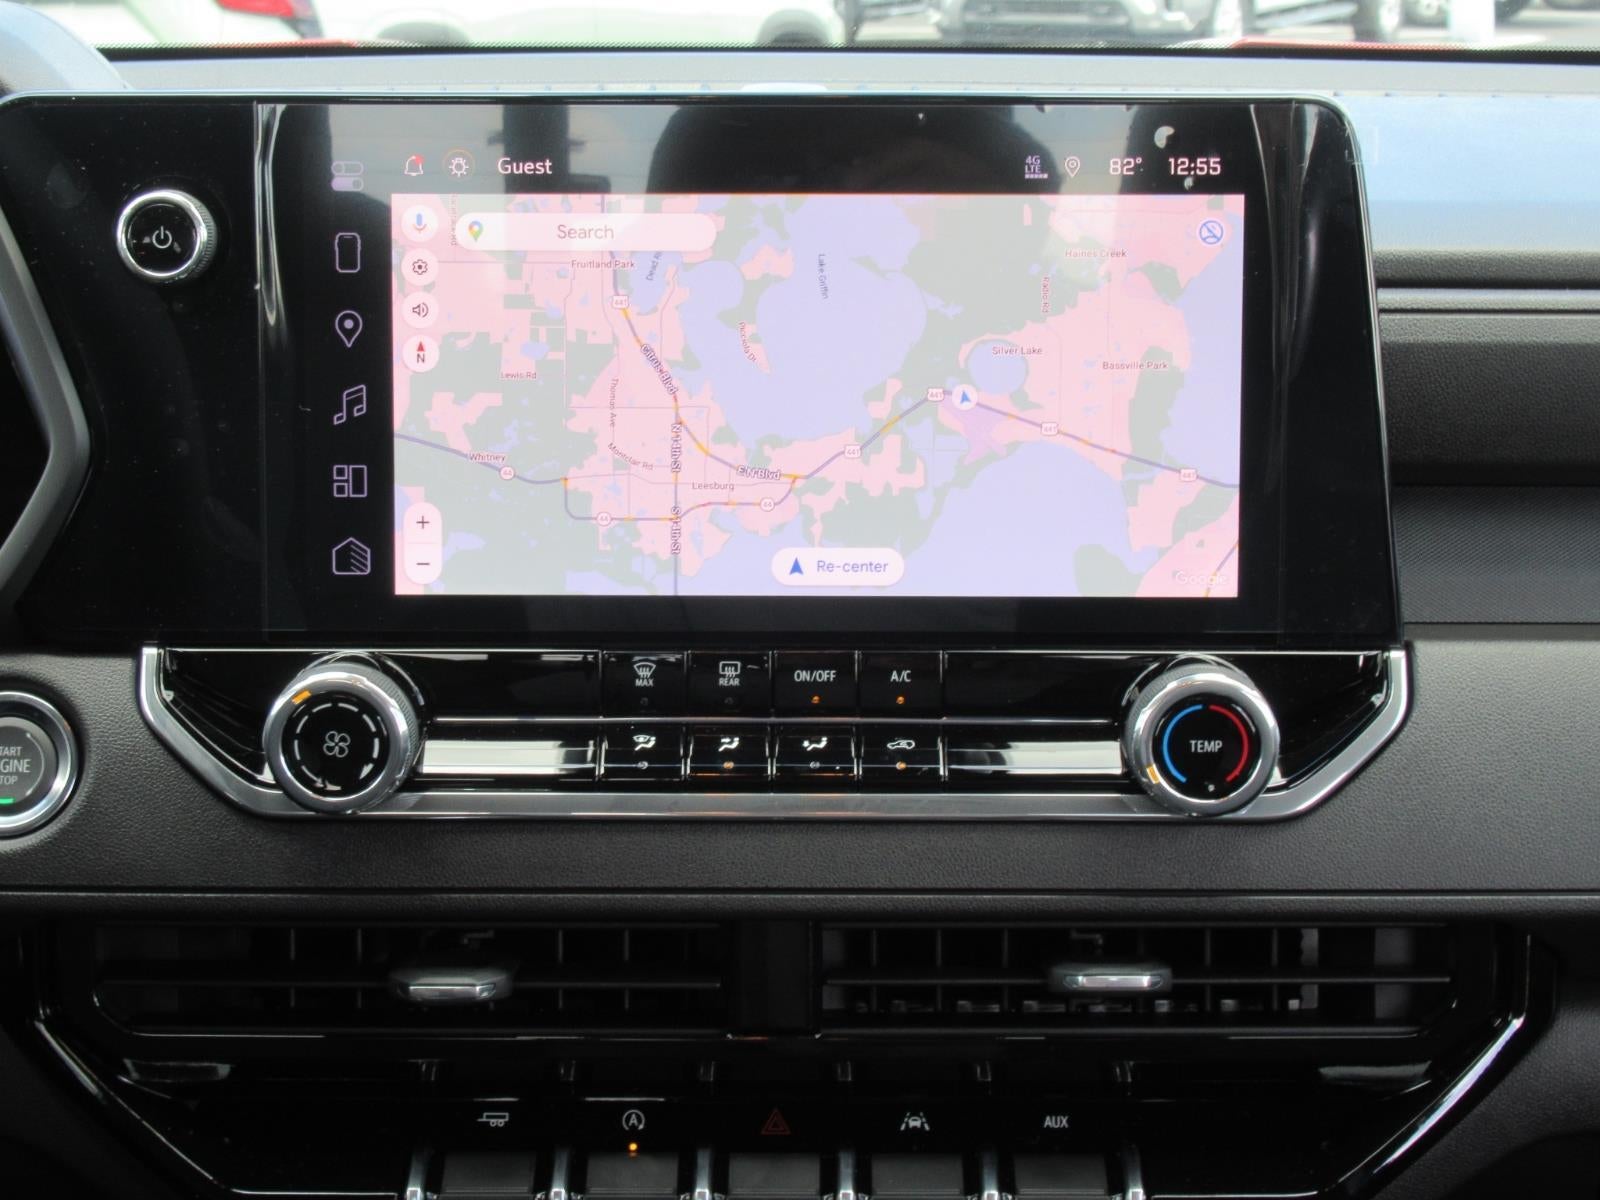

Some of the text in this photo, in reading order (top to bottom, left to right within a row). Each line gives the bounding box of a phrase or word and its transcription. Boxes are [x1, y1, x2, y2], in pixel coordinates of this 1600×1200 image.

[497, 157, 553, 174] Guest
[1025, 155, 1040, 165] 4G
[1025, 165, 1041, 174] LTE
[1168, 157, 1221, 175] 12:55
[557, 224, 614, 240] Search
[1065, 249, 1127, 258] Haines Creek
[571, 259, 635, 269] Fruitland Park
[818, 254, 826, 274] Lake
[992, 346, 1042, 355] Silver Lake
[416, 353, 426, 364] N
[1102, 361, 1168, 370] Bassville Park
[501, 371, 537, 380] Lewis Rd
[609, 378, 619, 427] Thomas Ave
[469, 453, 506, 462] Whitney
[608, 442, 654, 471] Montclair Rd
[692, 481, 735, 492] Leesburg
[816, 559, 889, 573] Re-center
[1175, 570, 1227, 588] Google
[794, 669, 837, 683] ON/OFF
[890, 669, 912, 683] A/C
[635, 678, 654, 687] MAX
[719, 677, 740, 687] REAR
[0, 746, 23, 757] TART
[1189, 740, 1223, 753] TEMP
[0, 758, 32, 773] GINE
[0, 775, 19, 785] TOP
[1044, 1115, 1069, 1129] AUX
